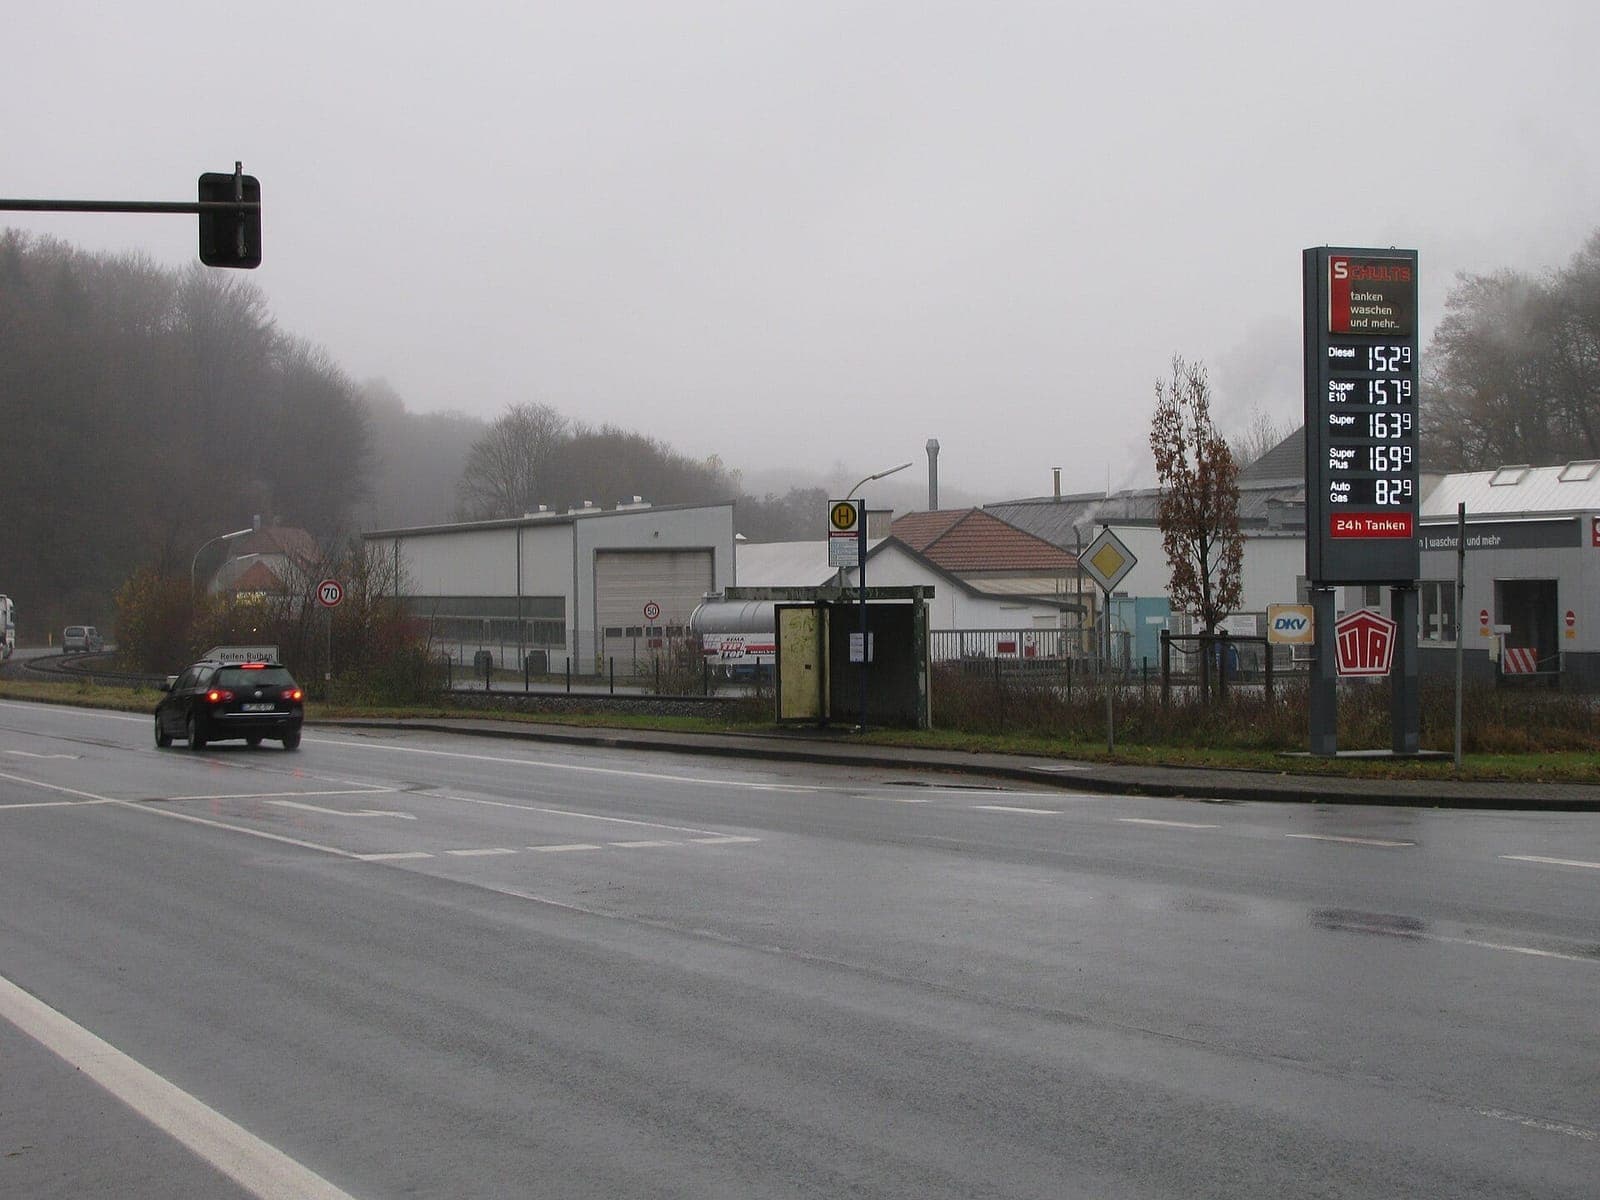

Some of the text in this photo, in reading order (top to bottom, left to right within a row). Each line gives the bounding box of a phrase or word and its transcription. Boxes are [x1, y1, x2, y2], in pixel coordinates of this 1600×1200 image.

[1350, 291, 1383, 301] tanken
[1350, 305, 1392, 315] waschen
[1350, 318, 1367, 328] und
[1328, 347, 1355, 357] Diesel
[1328, 380, 1355, 392] Super
[1328, 392, 1346, 402] E10
[1329, 414, 1355, 426] Super
[1329, 448, 1355, 459] Super
[1329, 459, 1348, 469] Plus
[1330, 481, 1351, 491] Auto
[1329, 493, 1349, 503] Gas
[838, 508, 849, 523] H
[1365, 520, 1406, 530] Tanken
[1466, 535, 1481, 546] und
[323, 587, 338, 600] 70
[647, 606, 657, 615] 50
[1274, 618, 1307, 630] DKV
[1338, 617, 1389, 668] UTA
[220, 652, 244, 660] Reifen
